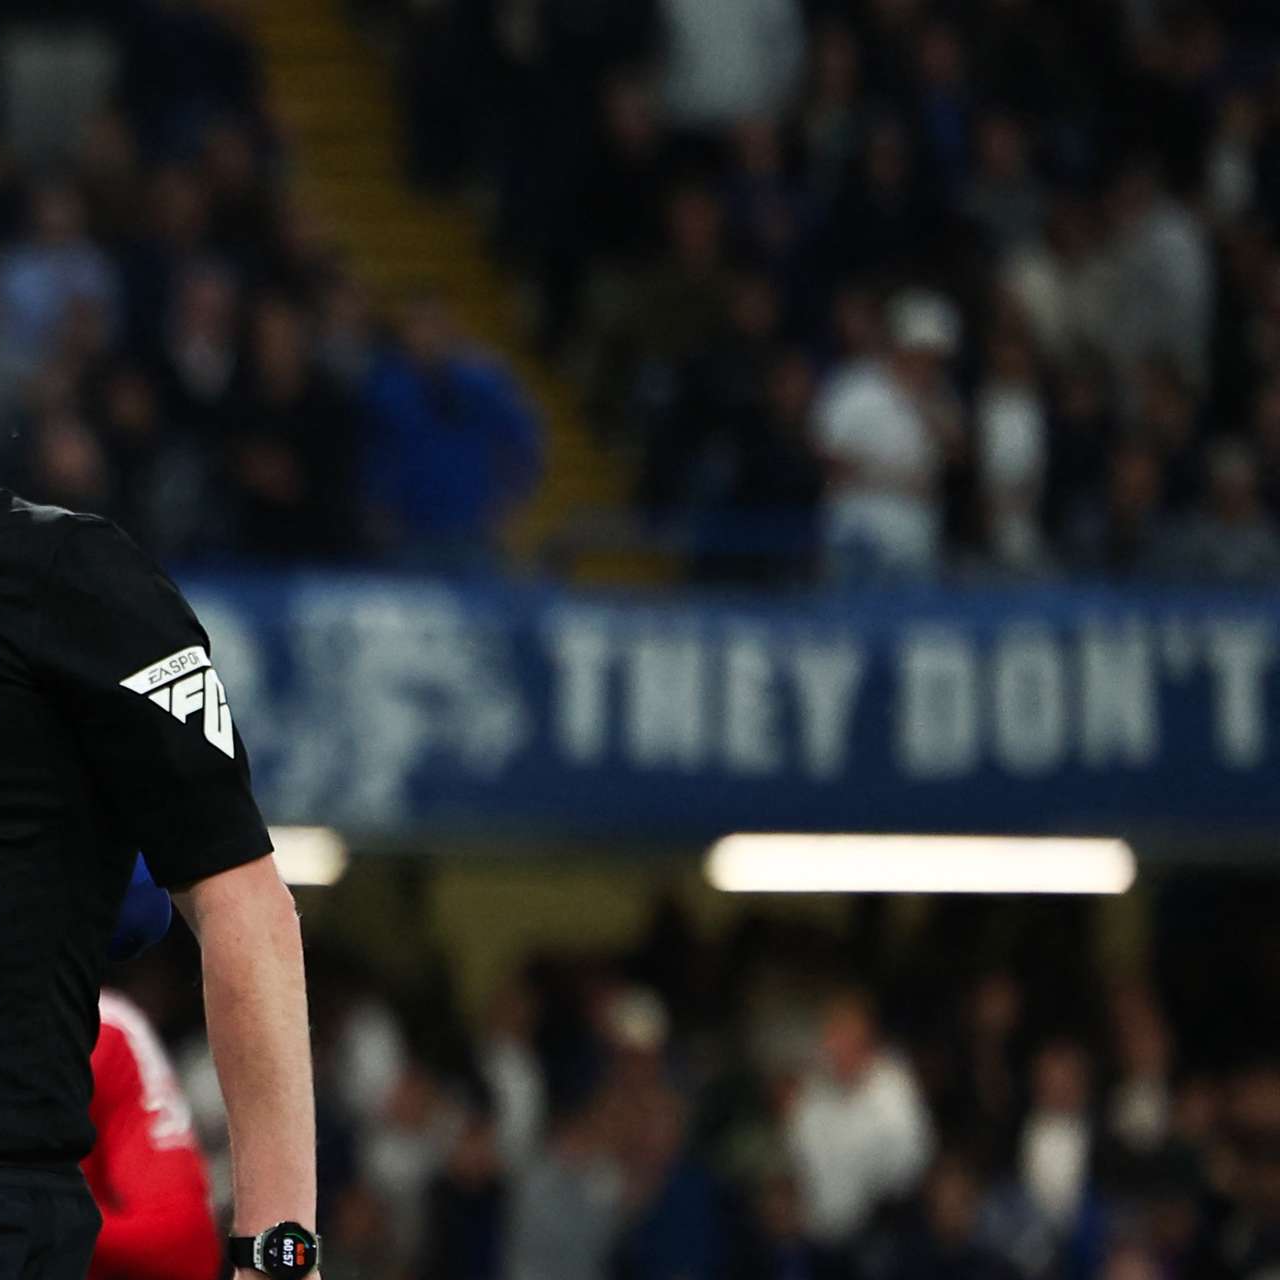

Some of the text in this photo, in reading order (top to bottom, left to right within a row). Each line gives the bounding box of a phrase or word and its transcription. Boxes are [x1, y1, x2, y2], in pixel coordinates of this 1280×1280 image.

[168, 651, 201, 674] SPO
[546, 606, 1280, 780] THEY DON'T
